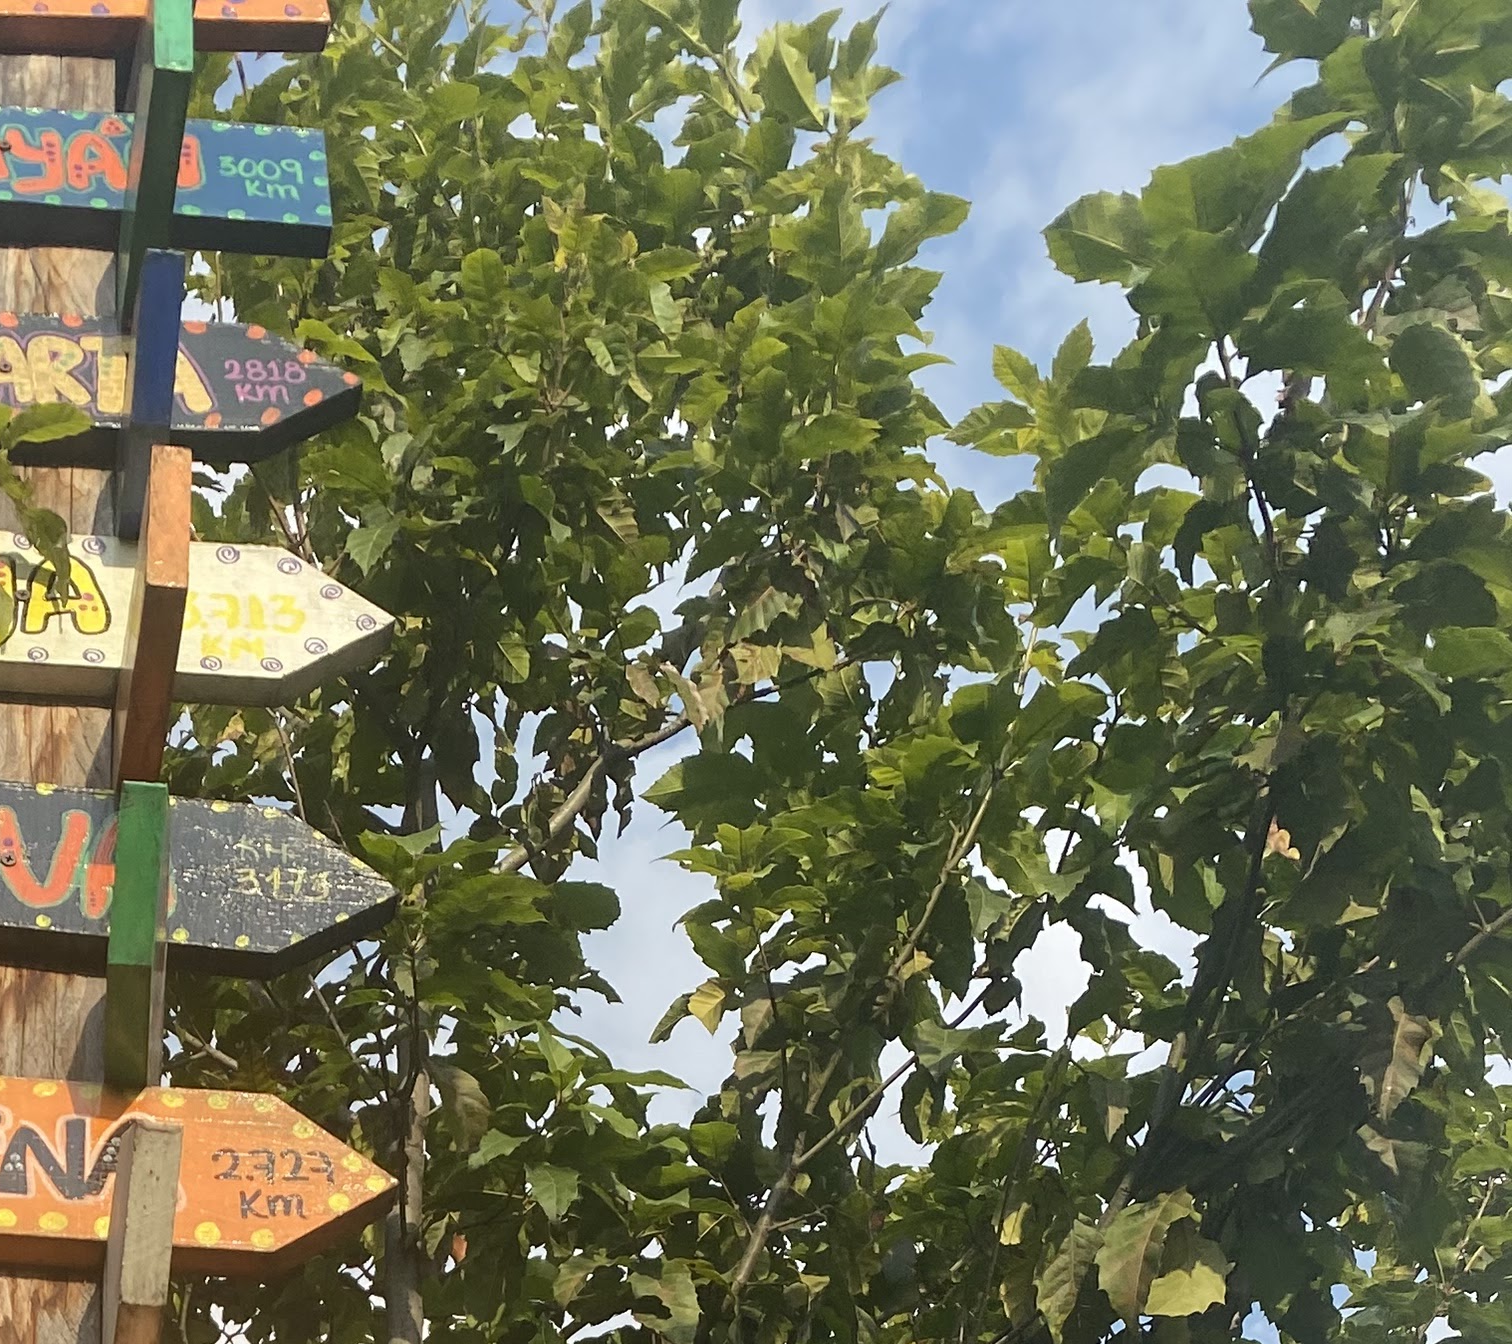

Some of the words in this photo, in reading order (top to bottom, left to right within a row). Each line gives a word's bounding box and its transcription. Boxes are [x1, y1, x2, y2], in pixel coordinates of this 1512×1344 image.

[218, 155, 304, 185] 3009
[223, 359, 306, 384] 2818
[211, 1148, 336, 1185] 2.727
